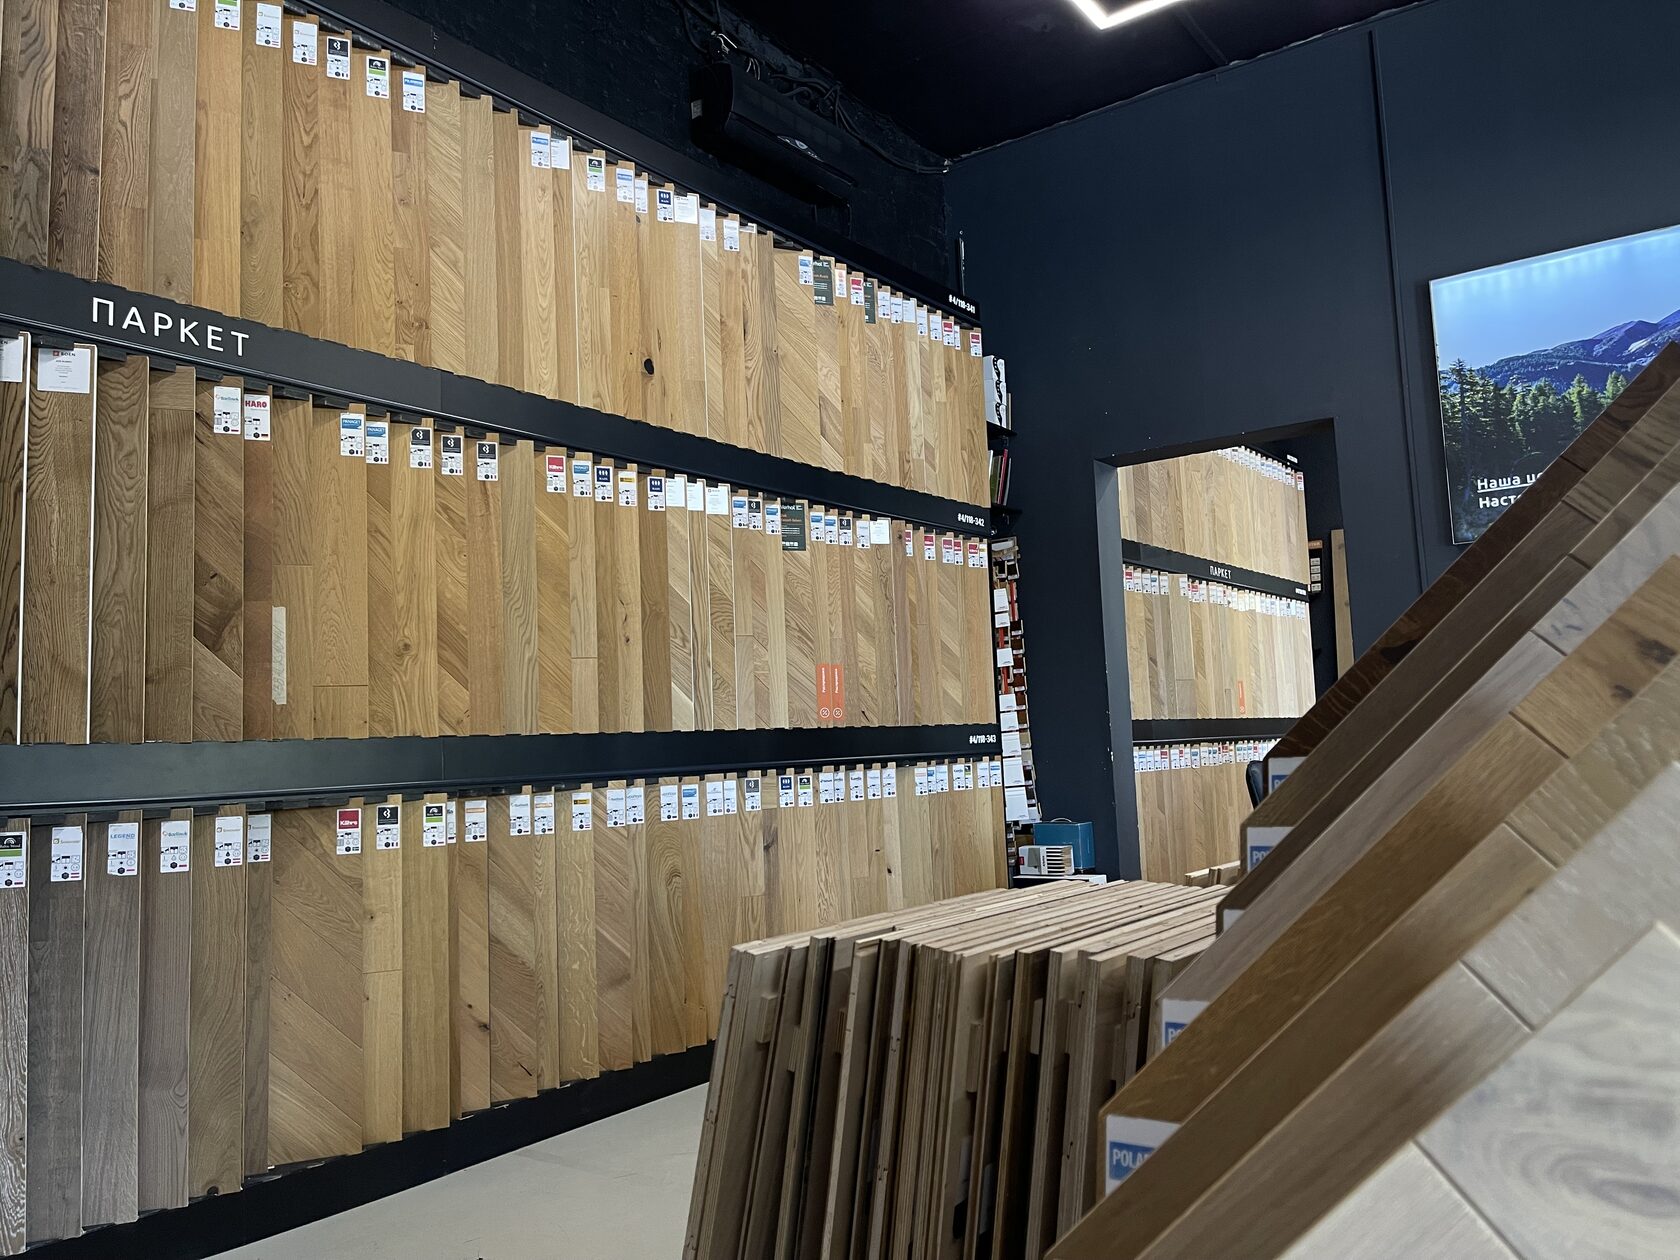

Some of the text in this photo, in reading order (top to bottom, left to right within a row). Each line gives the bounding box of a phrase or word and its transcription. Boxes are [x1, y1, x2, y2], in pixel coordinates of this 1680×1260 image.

[92, 297, 250, 357] ПАРКЕТ
[245, 400, 267, 408] HARO
[1477, 475, 1521, 490] Наша
[1479, 494, 1522, 509] Наст
[1209, 565, 1232, 580] ПАРКЕТ
